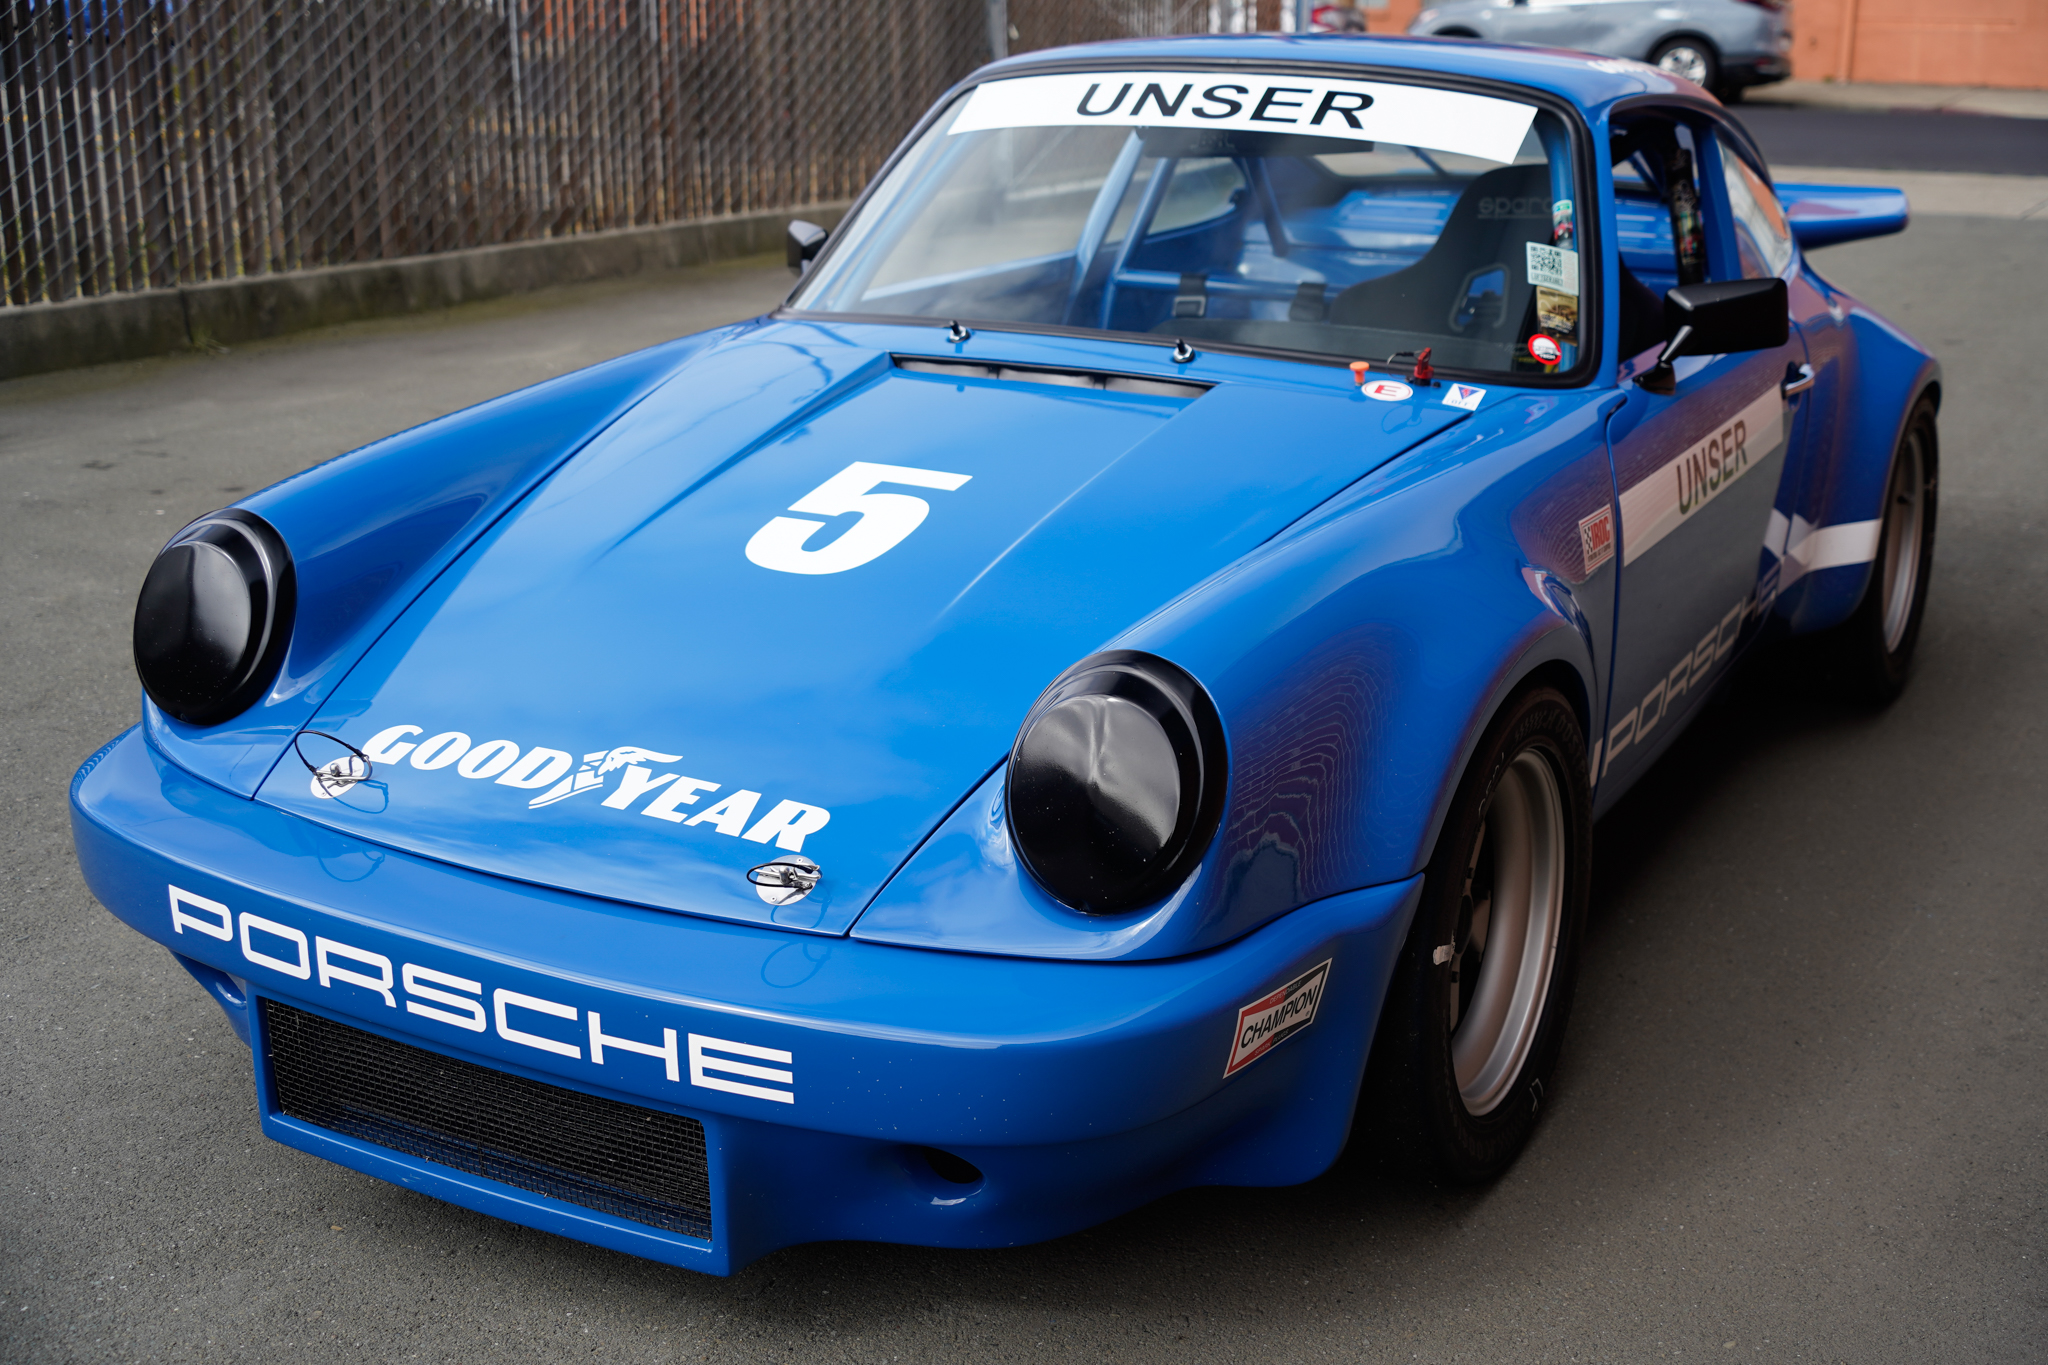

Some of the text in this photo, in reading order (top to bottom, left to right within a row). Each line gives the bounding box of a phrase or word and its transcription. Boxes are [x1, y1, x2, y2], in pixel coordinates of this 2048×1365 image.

[1077, 83, 1375, 130] UNSER
[1373, 384, 1402, 397] E
[1676, 420, 1748, 515] UNSER
[745, 461, 974, 575] 5
[1590, 515, 1611, 551] IROC
[1601, 561, 1781, 778] PORSCHE
[168, 884, 794, 1104] PORSCHE
[1240, 984, 1318, 1049] CHAMPION
